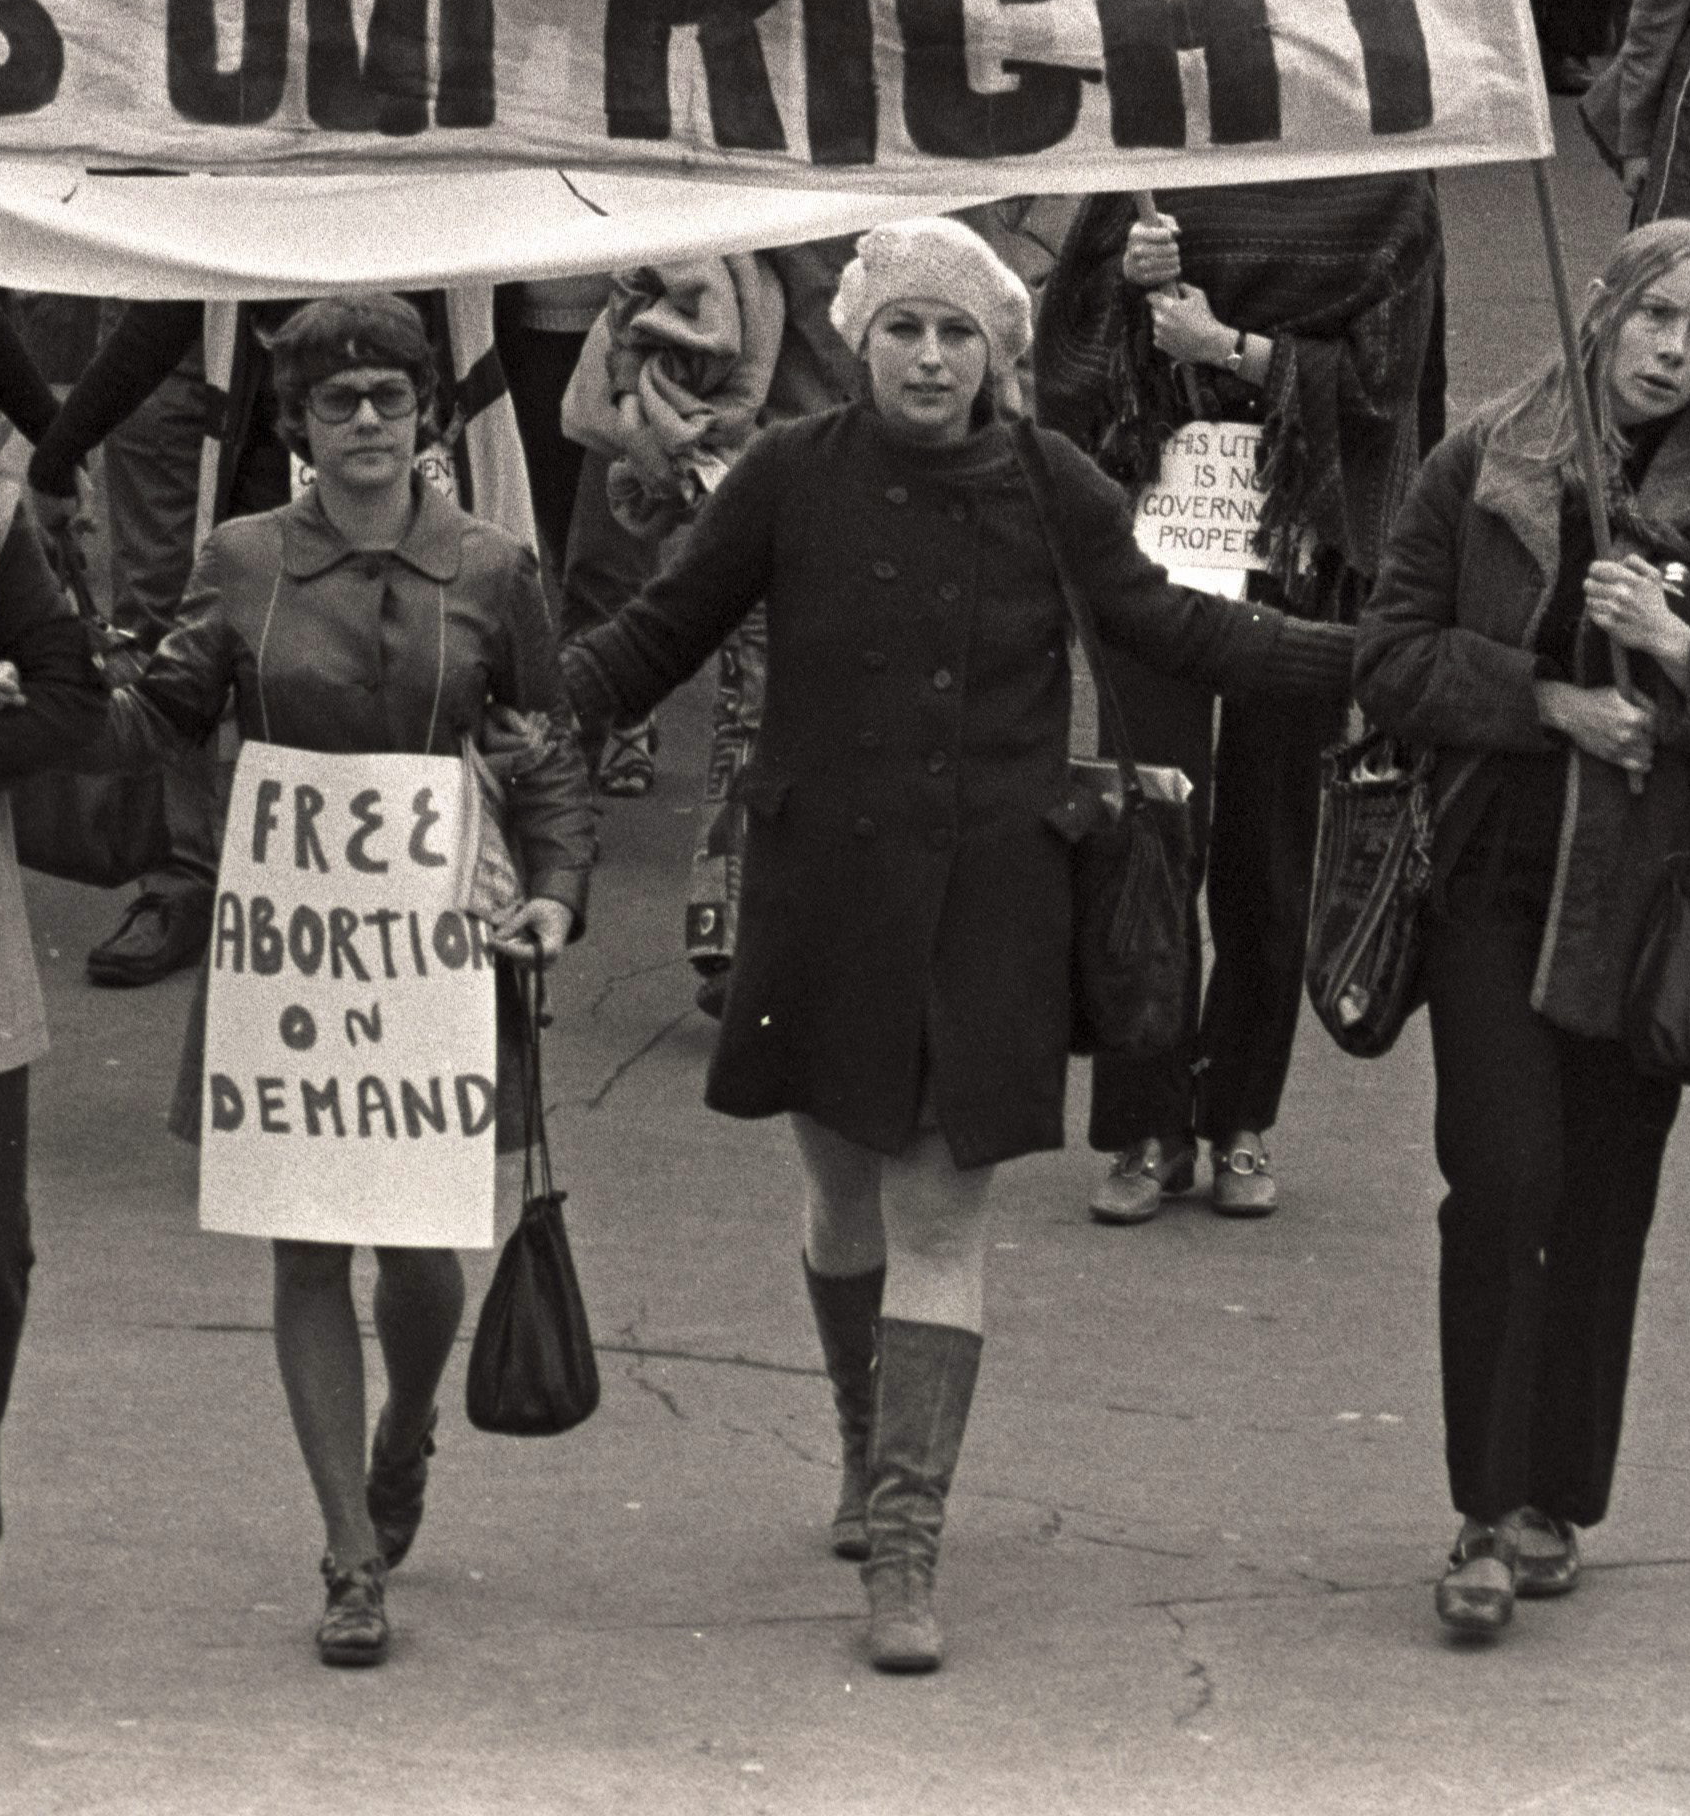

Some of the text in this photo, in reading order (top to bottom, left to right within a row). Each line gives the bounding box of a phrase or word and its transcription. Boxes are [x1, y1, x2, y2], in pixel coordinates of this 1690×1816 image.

[1194, 464, 1217, 488] IS
[252, 779, 448, 874] FREE
[278, 1001, 384, 1053] ON
[210, 1072, 496, 1140] DEMAND
